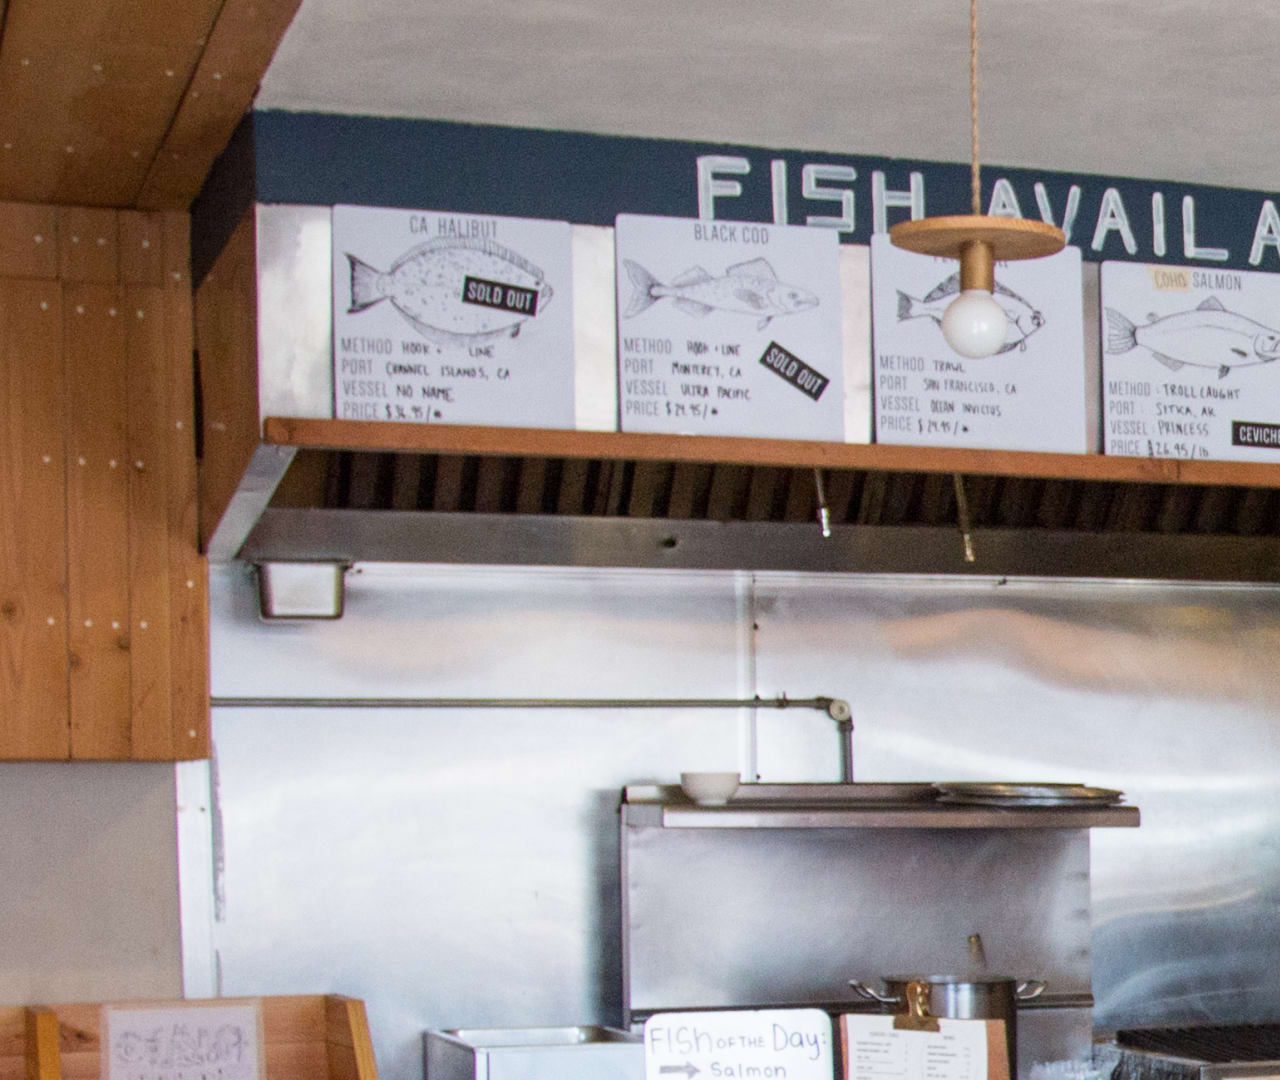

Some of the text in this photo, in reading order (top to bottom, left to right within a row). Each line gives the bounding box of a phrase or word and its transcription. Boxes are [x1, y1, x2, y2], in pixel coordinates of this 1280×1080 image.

[697, 155, 925, 234] FISH
[410, 216, 498, 238] CA HALIBUT
[694, 225, 769, 245] BLACK COD
[1193, 273, 1241, 291] SALMON
[468, 282, 532, 310] SOLD OUT
[341, 338, 392, 354] METHOD
[469, 347, 494, 357] LINE
[624, 339, 672, 354] METHOD
[722, 344, 740, 356] LINE
[342, 359, 372, 375] PORT
[497, 369, 510, 379] CA
[625, 359, 654, 374] PORT
[766, 349, 823, 394] SOLD OUT
[880, 356, 965, 372] METHOD TRAWL
[343, 381, 387, 397] VESSEL
[626, 381, 667, 396] VESSEL
[880, 376, 907, 391] PORT
[924, 378, 939, 391] SAN
[1005, 383, 1016, 394] CA
[1163, 383, 1194, 399] TROLL
[1200, 386, 1240, 399] CAUGHT
[343, 403, 378, 419] PRICE
[626, 401, 659, 416] PRICE
[881, 397, 920, 411] VESSEL
[1202, 407, 1215, 417] AK
[881, 416, 912, 431] PRICE
[1158, 420, 1209, 436] PRINCESS
[1111, 440, 1140, 455] PRICE
[717, 1036, 737, 1049] OF
[742, 1036, 766, 1048] THE
[710, 1061, 787, 1079] Salmon
